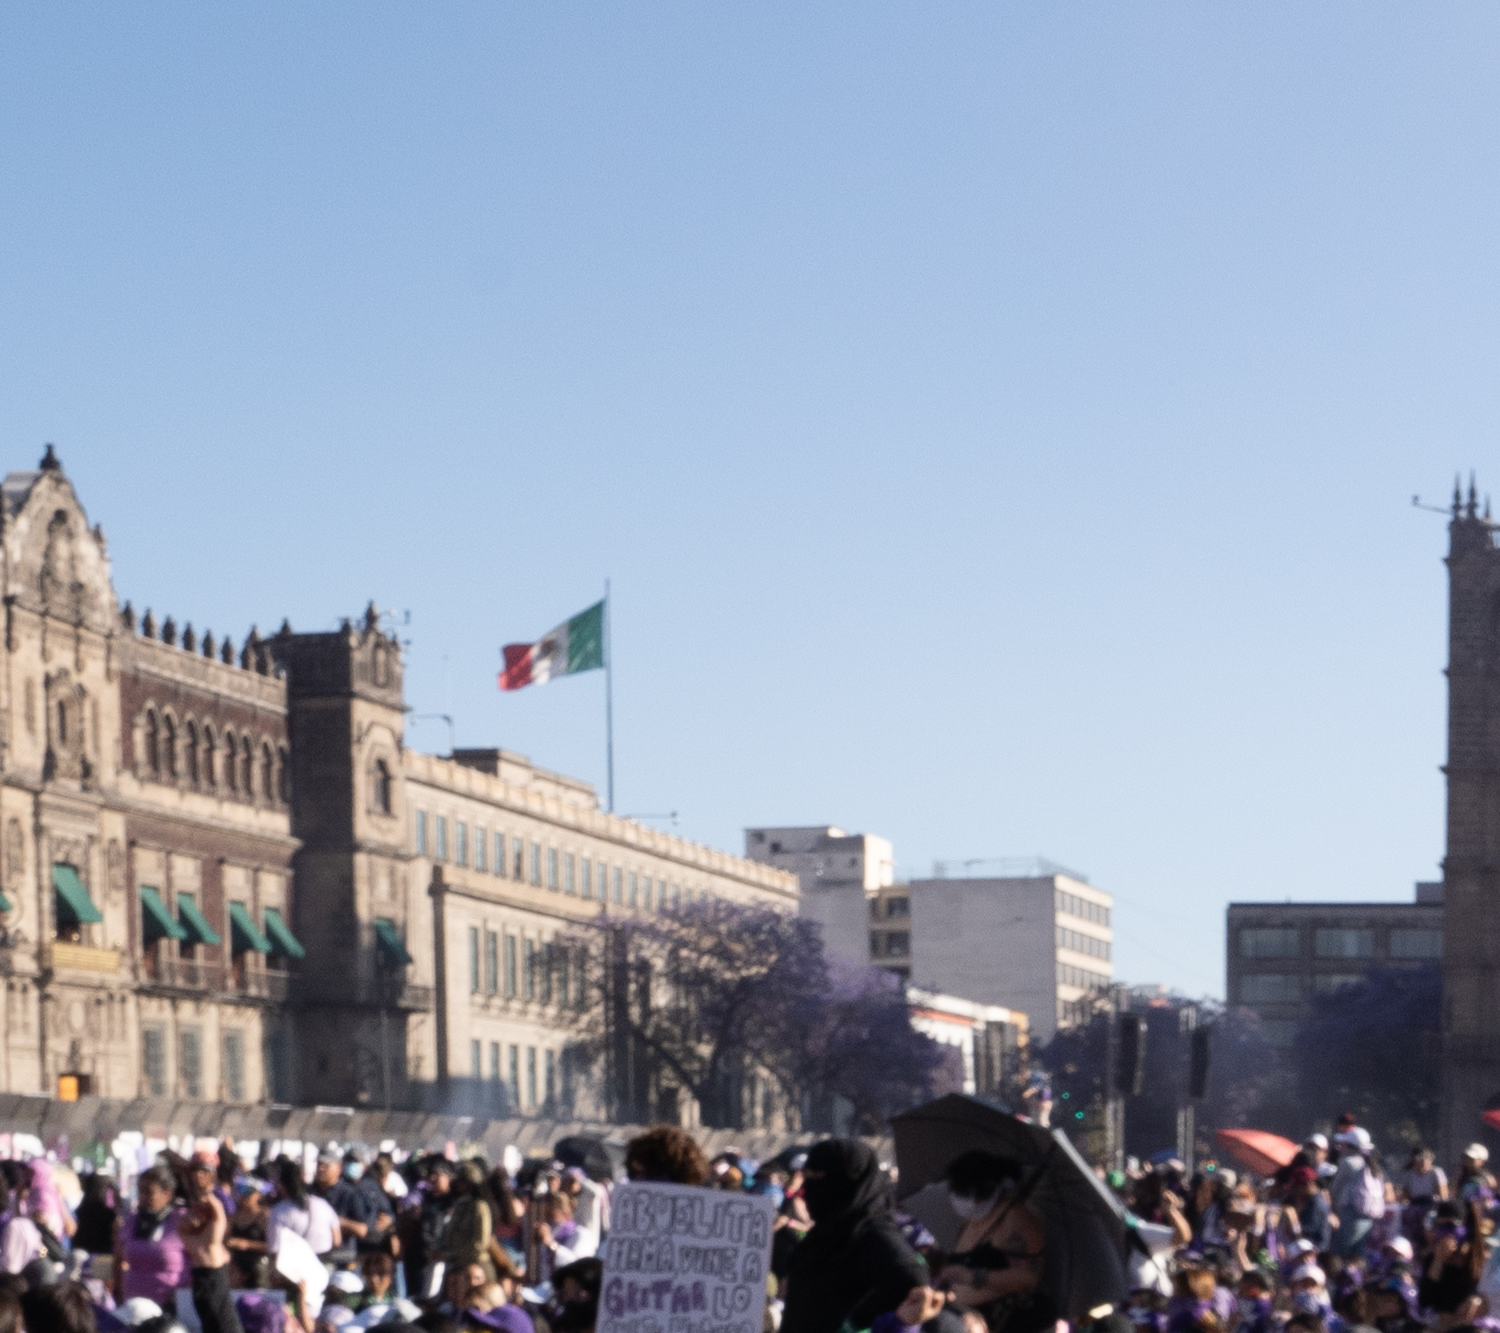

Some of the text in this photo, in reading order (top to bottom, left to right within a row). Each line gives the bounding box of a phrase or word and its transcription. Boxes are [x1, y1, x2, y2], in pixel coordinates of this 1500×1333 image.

[614, 1188, 769, 1249] ABUELITA
[741, 1250, 763, 1285] A
[605, 1276, 752, 1321] GRITAR LO
